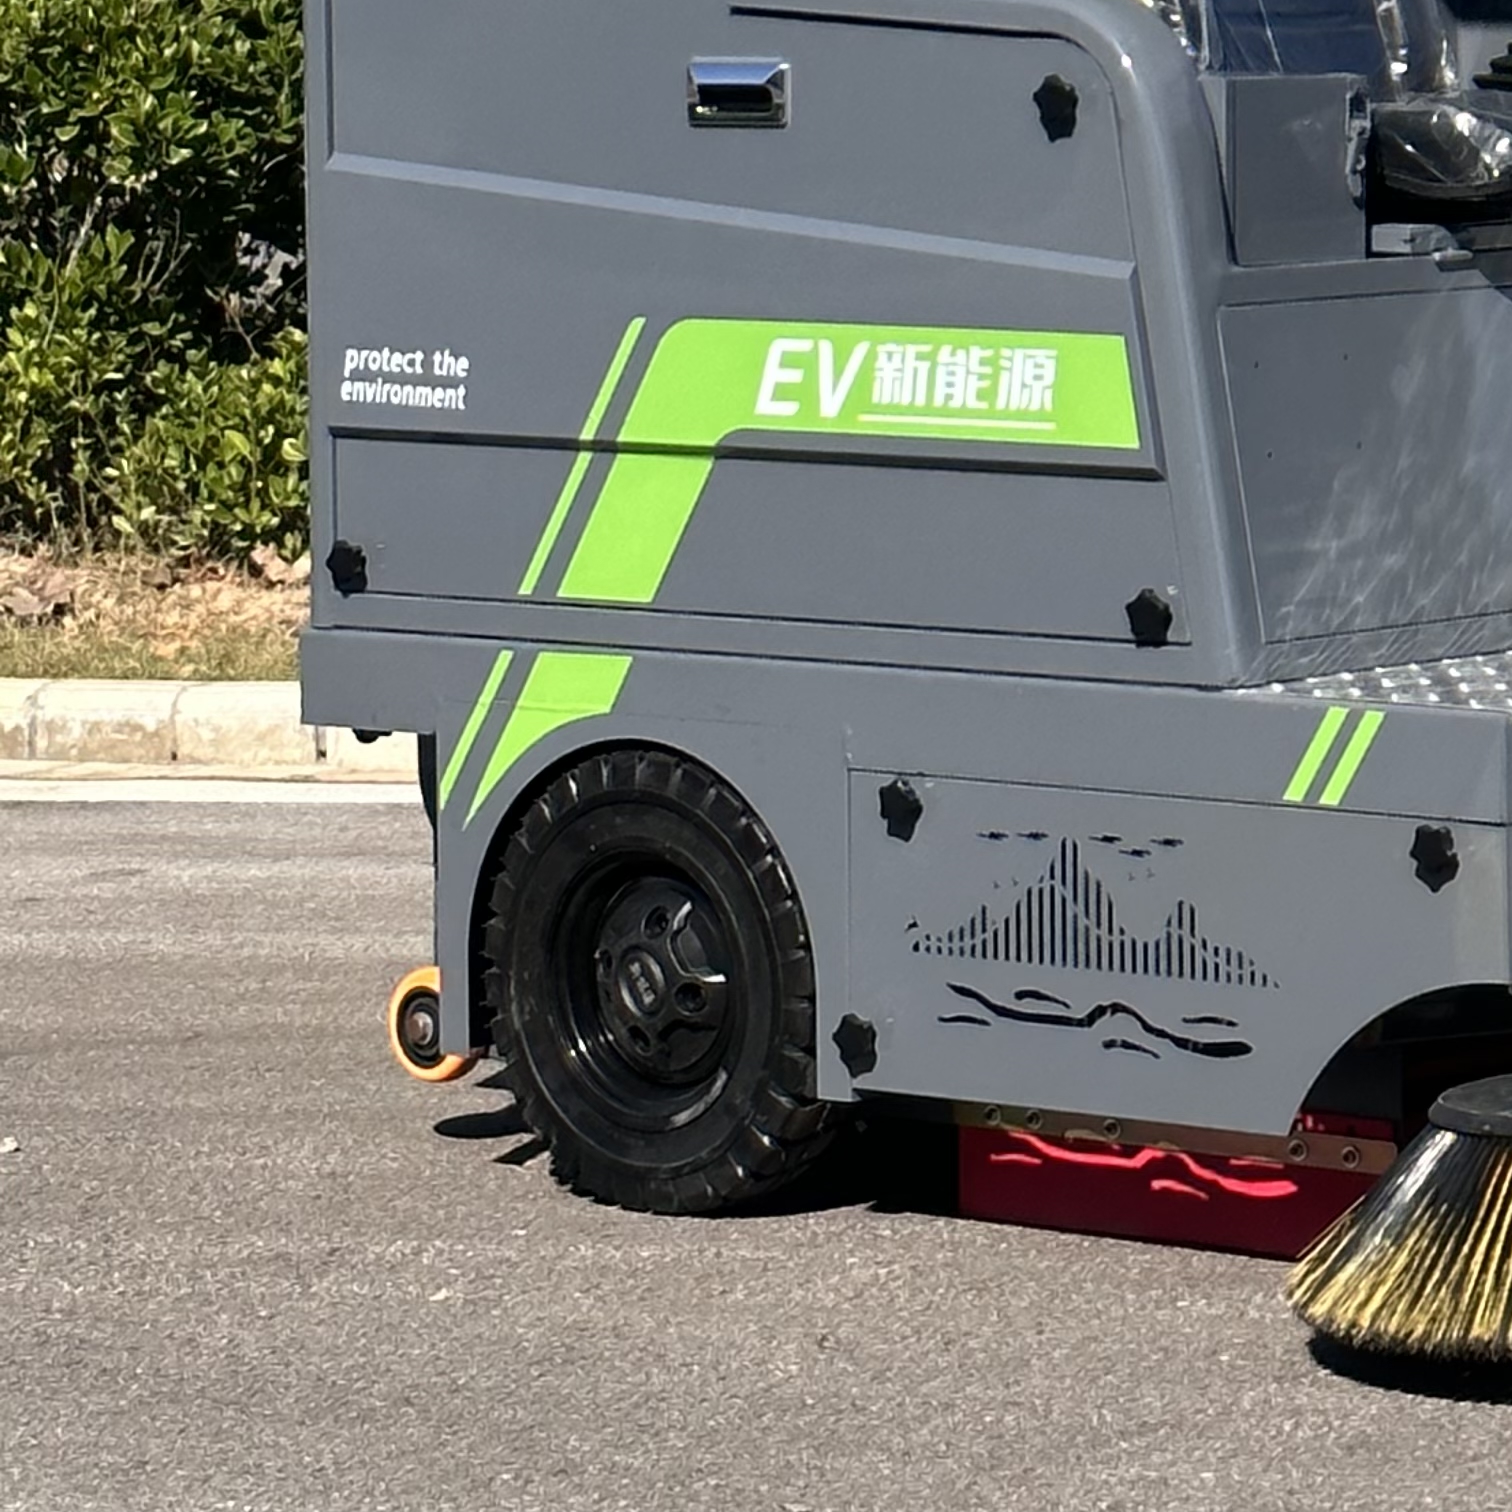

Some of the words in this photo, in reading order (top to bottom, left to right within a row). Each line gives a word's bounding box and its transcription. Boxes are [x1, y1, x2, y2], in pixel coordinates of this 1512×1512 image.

[343, 346, 424, 378] protect
[433, 348, 470, 377] the
[340, 377, 467, 410] environment
